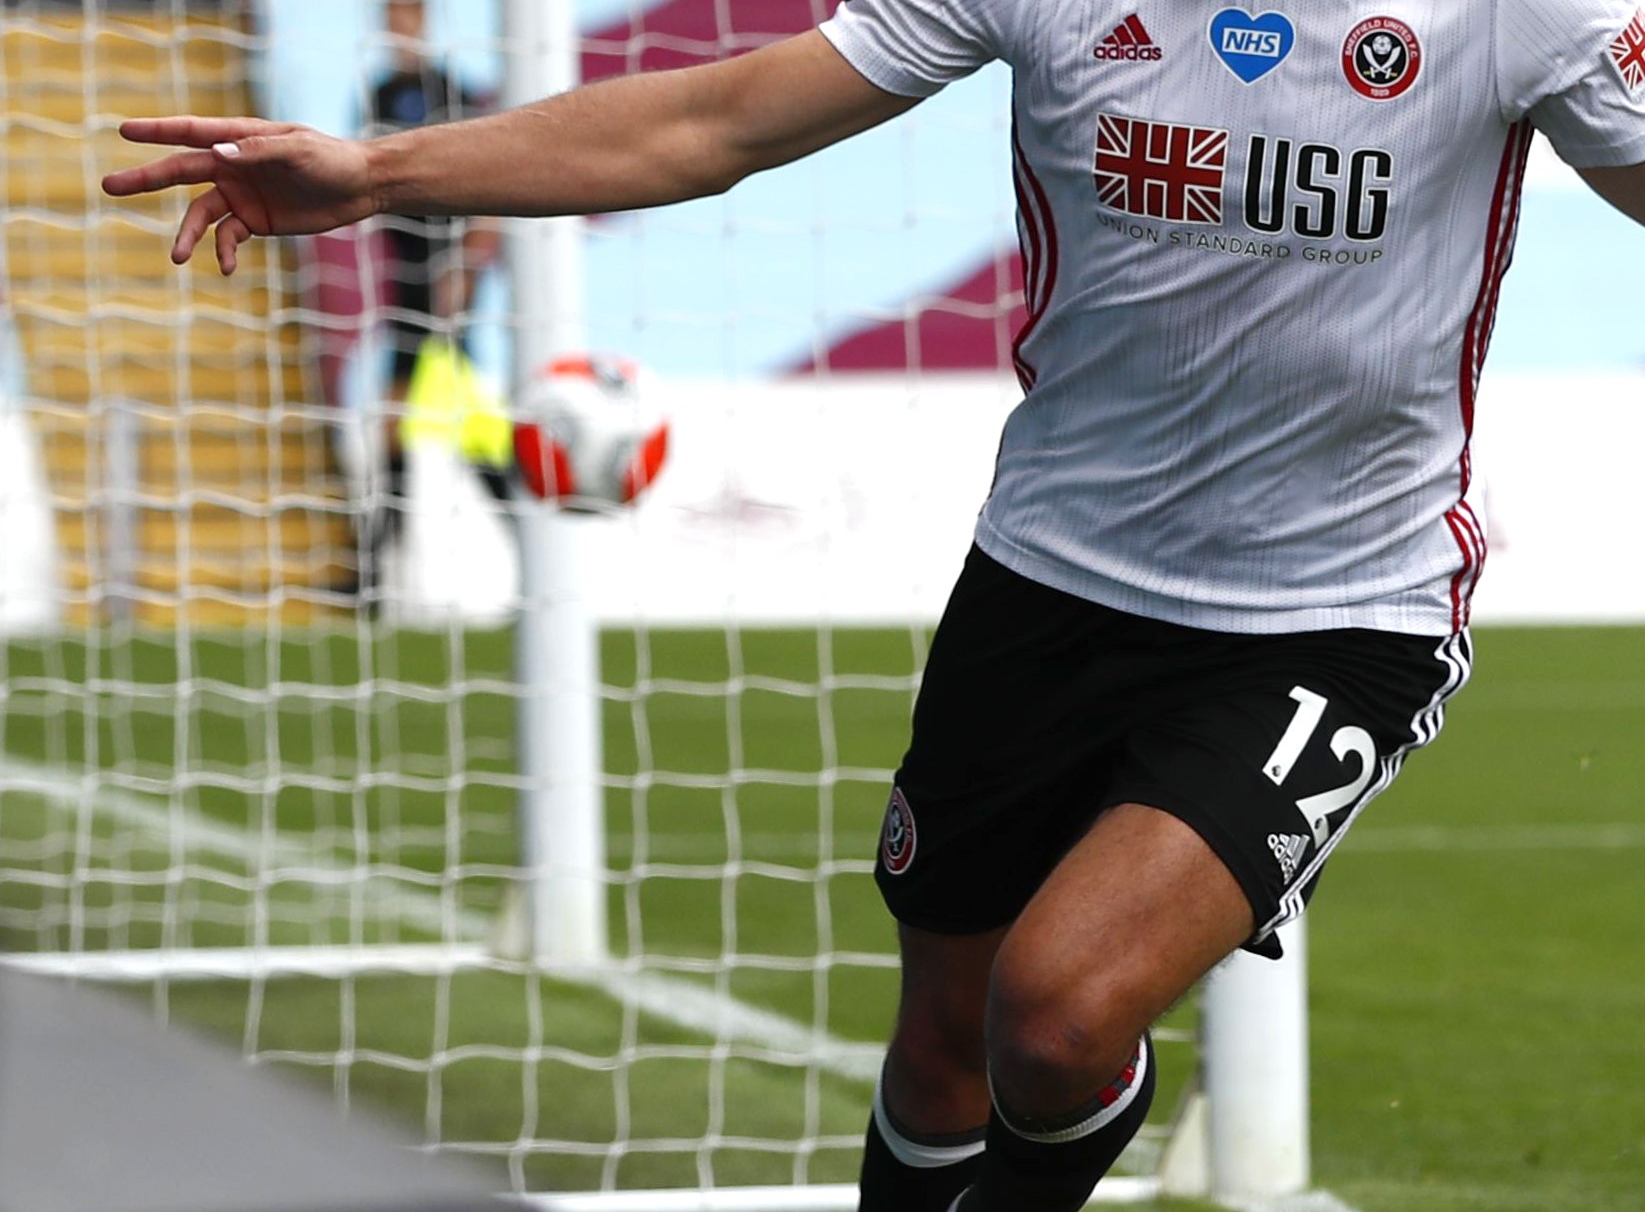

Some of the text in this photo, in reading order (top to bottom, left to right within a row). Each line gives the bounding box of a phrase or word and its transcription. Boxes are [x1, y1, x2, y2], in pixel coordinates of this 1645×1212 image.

[1093, 45, 1162, 61] adidas
[1224, 30, 1278, 54] NHS
[1244, 135, 1393, 241] USG
[1096, 213, 1384, 265] UNION STANDARD GROUP
[1262, 685, 1377, 850] 12
